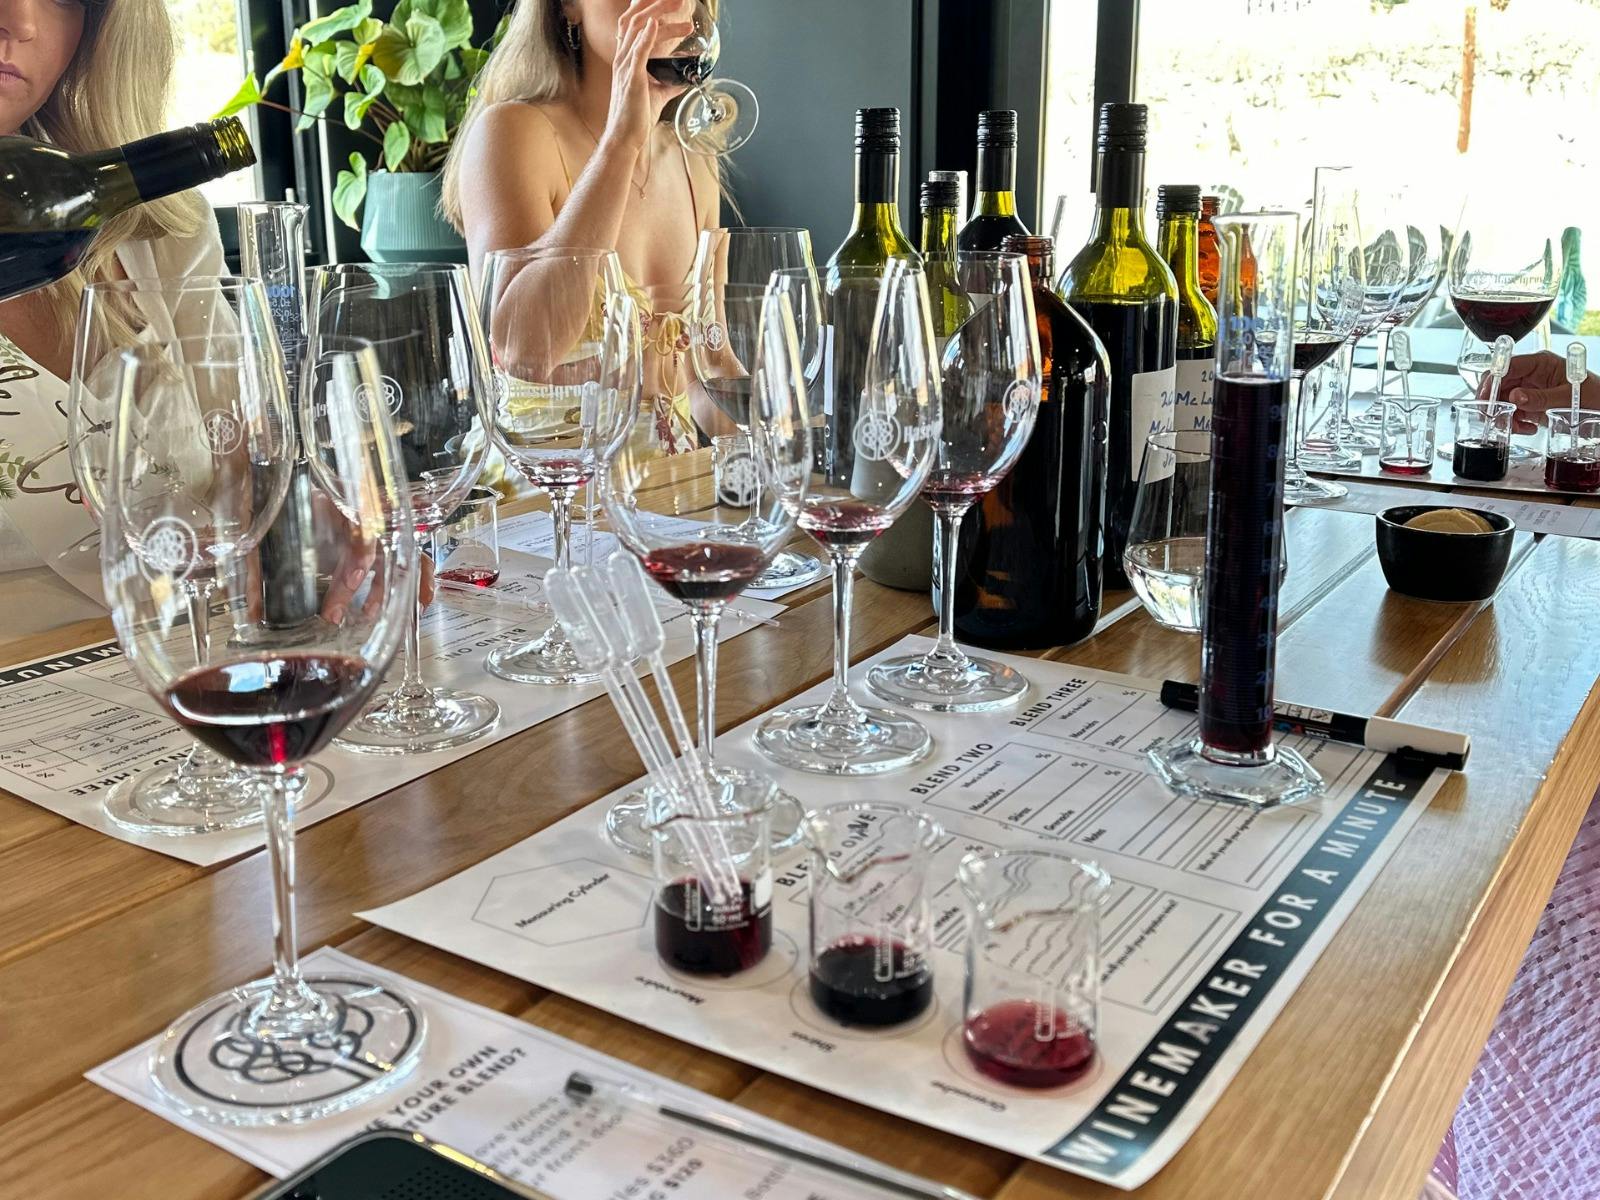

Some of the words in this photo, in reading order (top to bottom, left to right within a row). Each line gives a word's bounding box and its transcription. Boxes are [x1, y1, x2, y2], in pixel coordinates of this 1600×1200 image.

[475, 628, 527, 647] BLEND
[0, 646, 122, 685] MINUT
[1009, 701, 1053, 727] BLEND
[1046, 678, 1088, 702] THREE
[910, 764, 962, 796] BLEND
[955, 742, 995, 764] TWO
[1320, 778, 1407, 859] MINUTE
[1302, 867, 1340, 886] A
[1248, 893, 1319, 947] FOR
[388, 1079, 450, 1117] YOUR
[449, 1044, 499, 1079] OWN
[401, 1093, 459, 1131] TURE
[455, 1046, 528, 1096] BLEND?
[1059, 958, 1268, 1165] WINEMAKER
